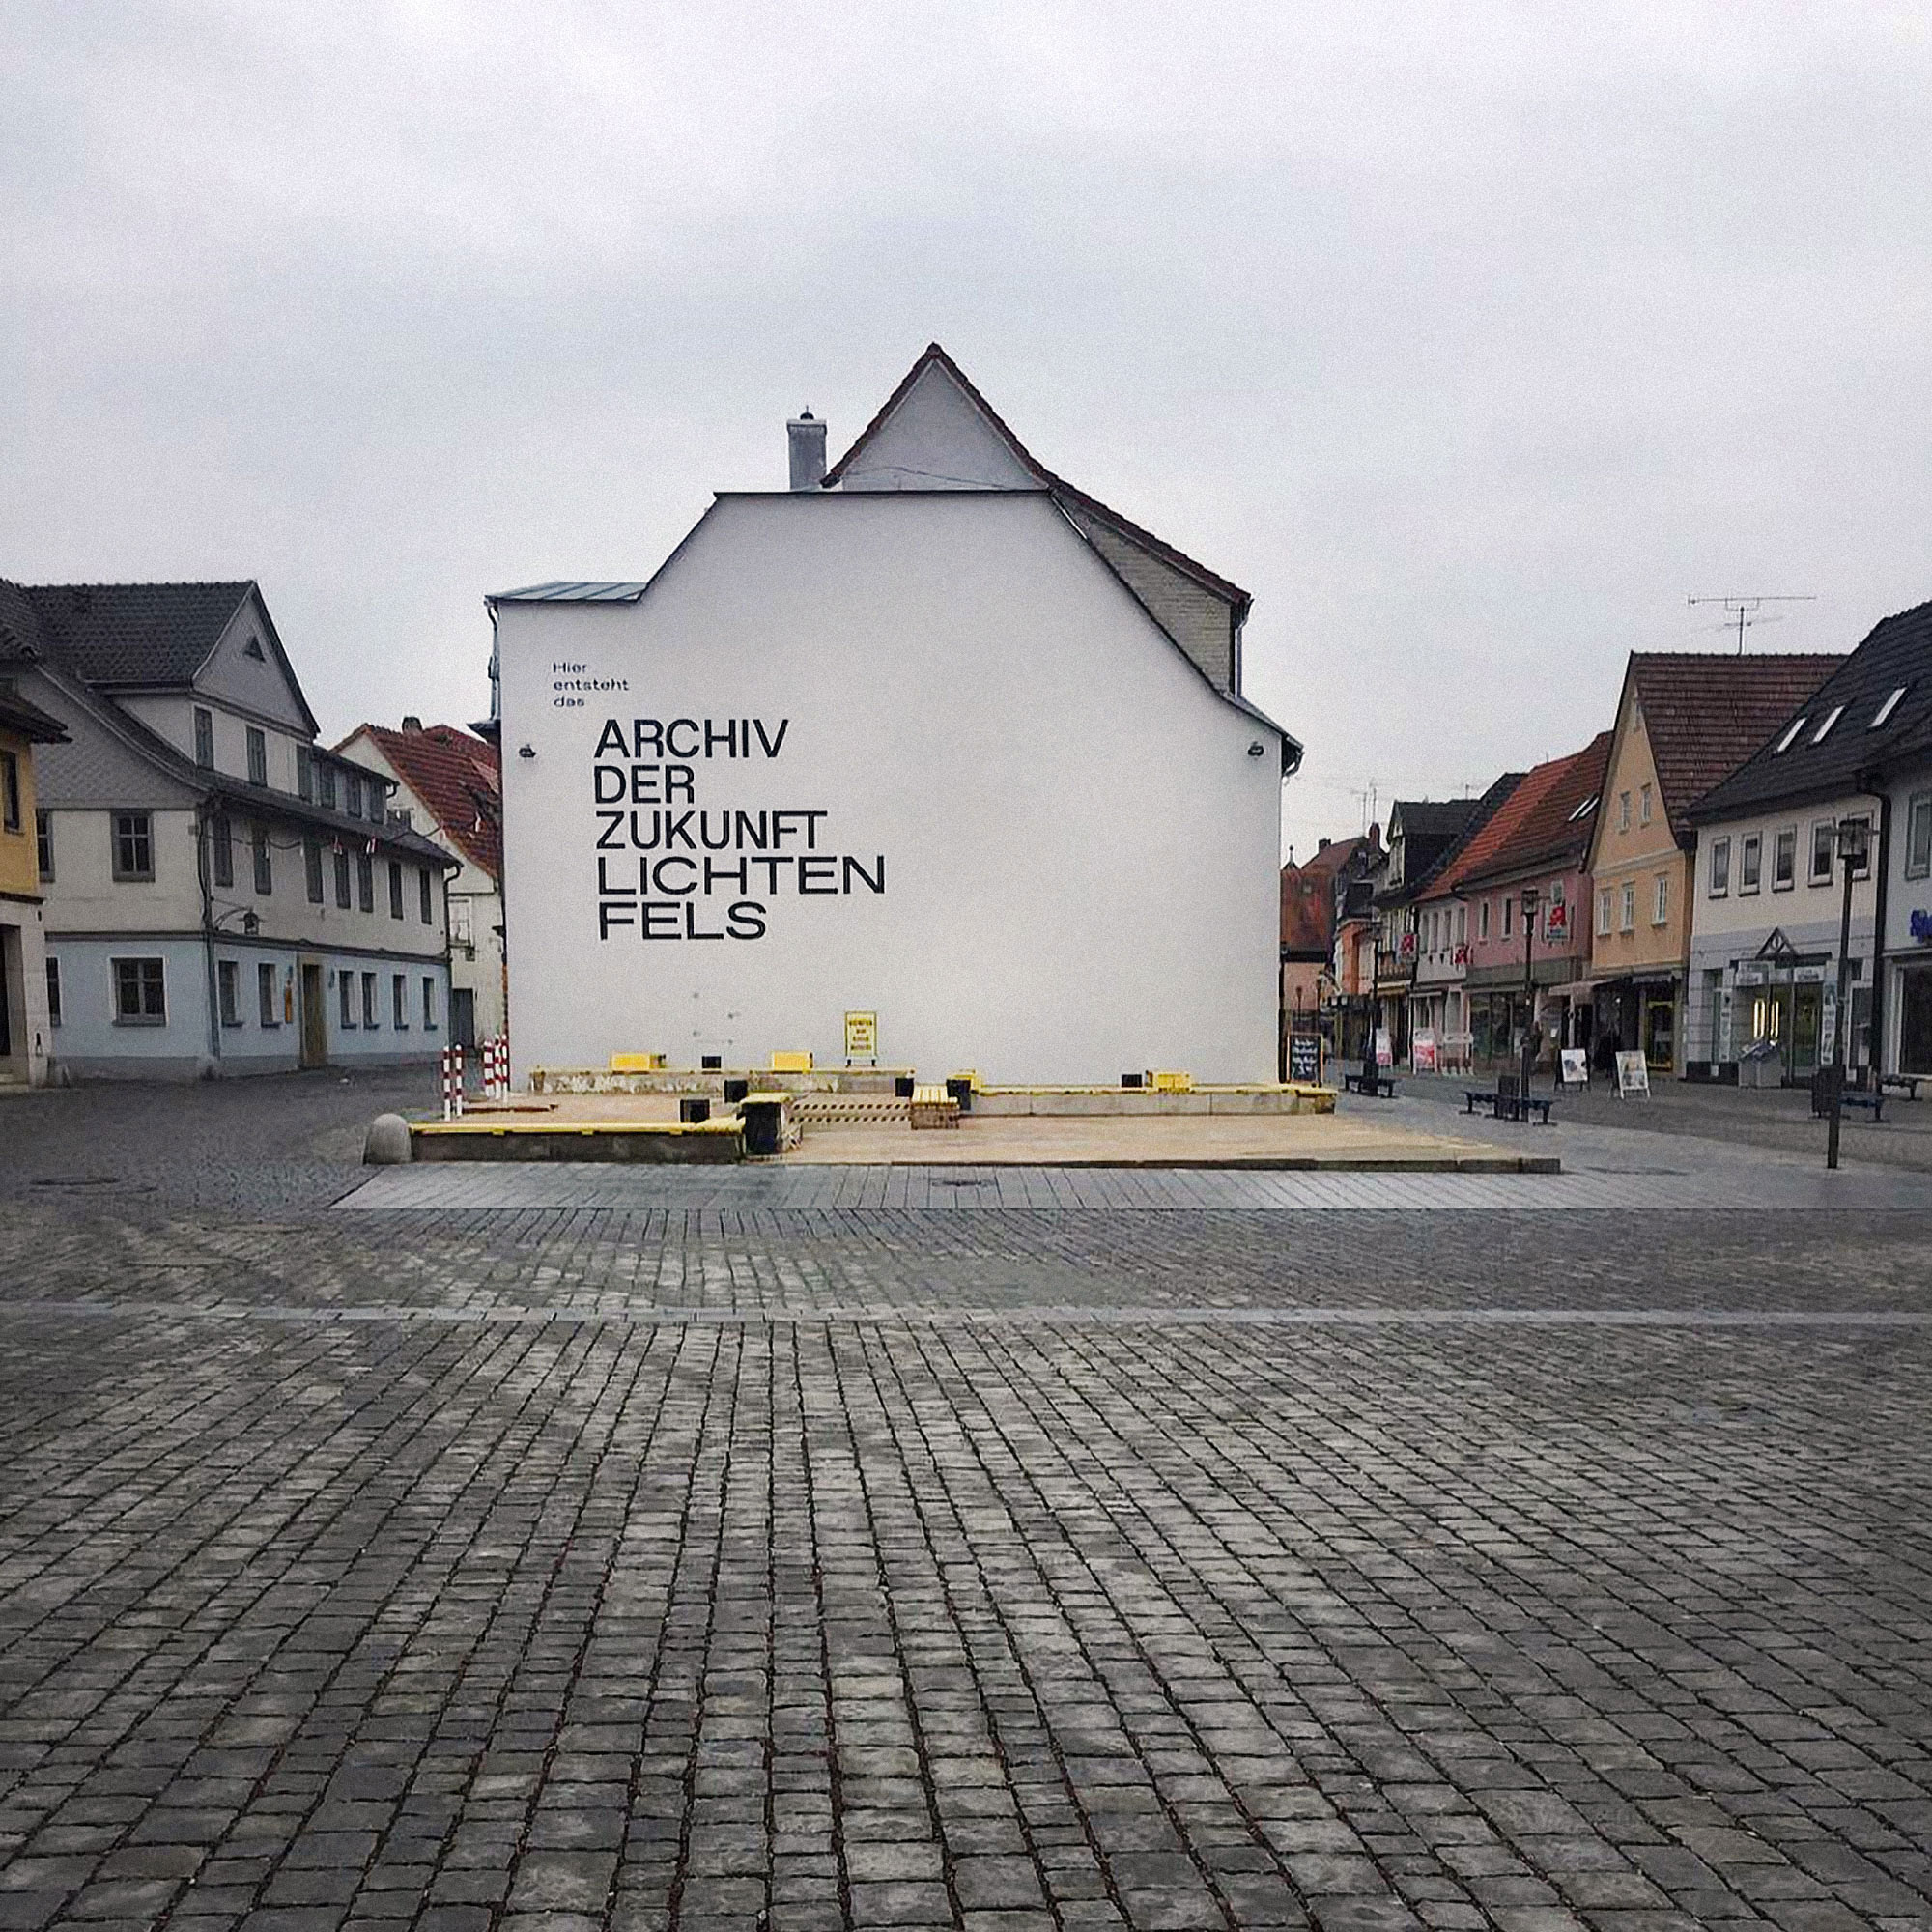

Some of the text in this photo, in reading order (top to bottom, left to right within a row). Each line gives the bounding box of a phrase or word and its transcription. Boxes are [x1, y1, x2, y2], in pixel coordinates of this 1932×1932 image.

[553, 662, 587, 674] Hier
[553, 678, 630, 692] entsteht
[553, 696, 585, 708] das
[593, 718, 789, 759] ARCHIV
[593, 764, 695, 805] DER
[595, 810, 829, 850] ZUKUNFT
[597, 854, 886, 895] LICHTEN
[598, 900, 767, 941] FELS
